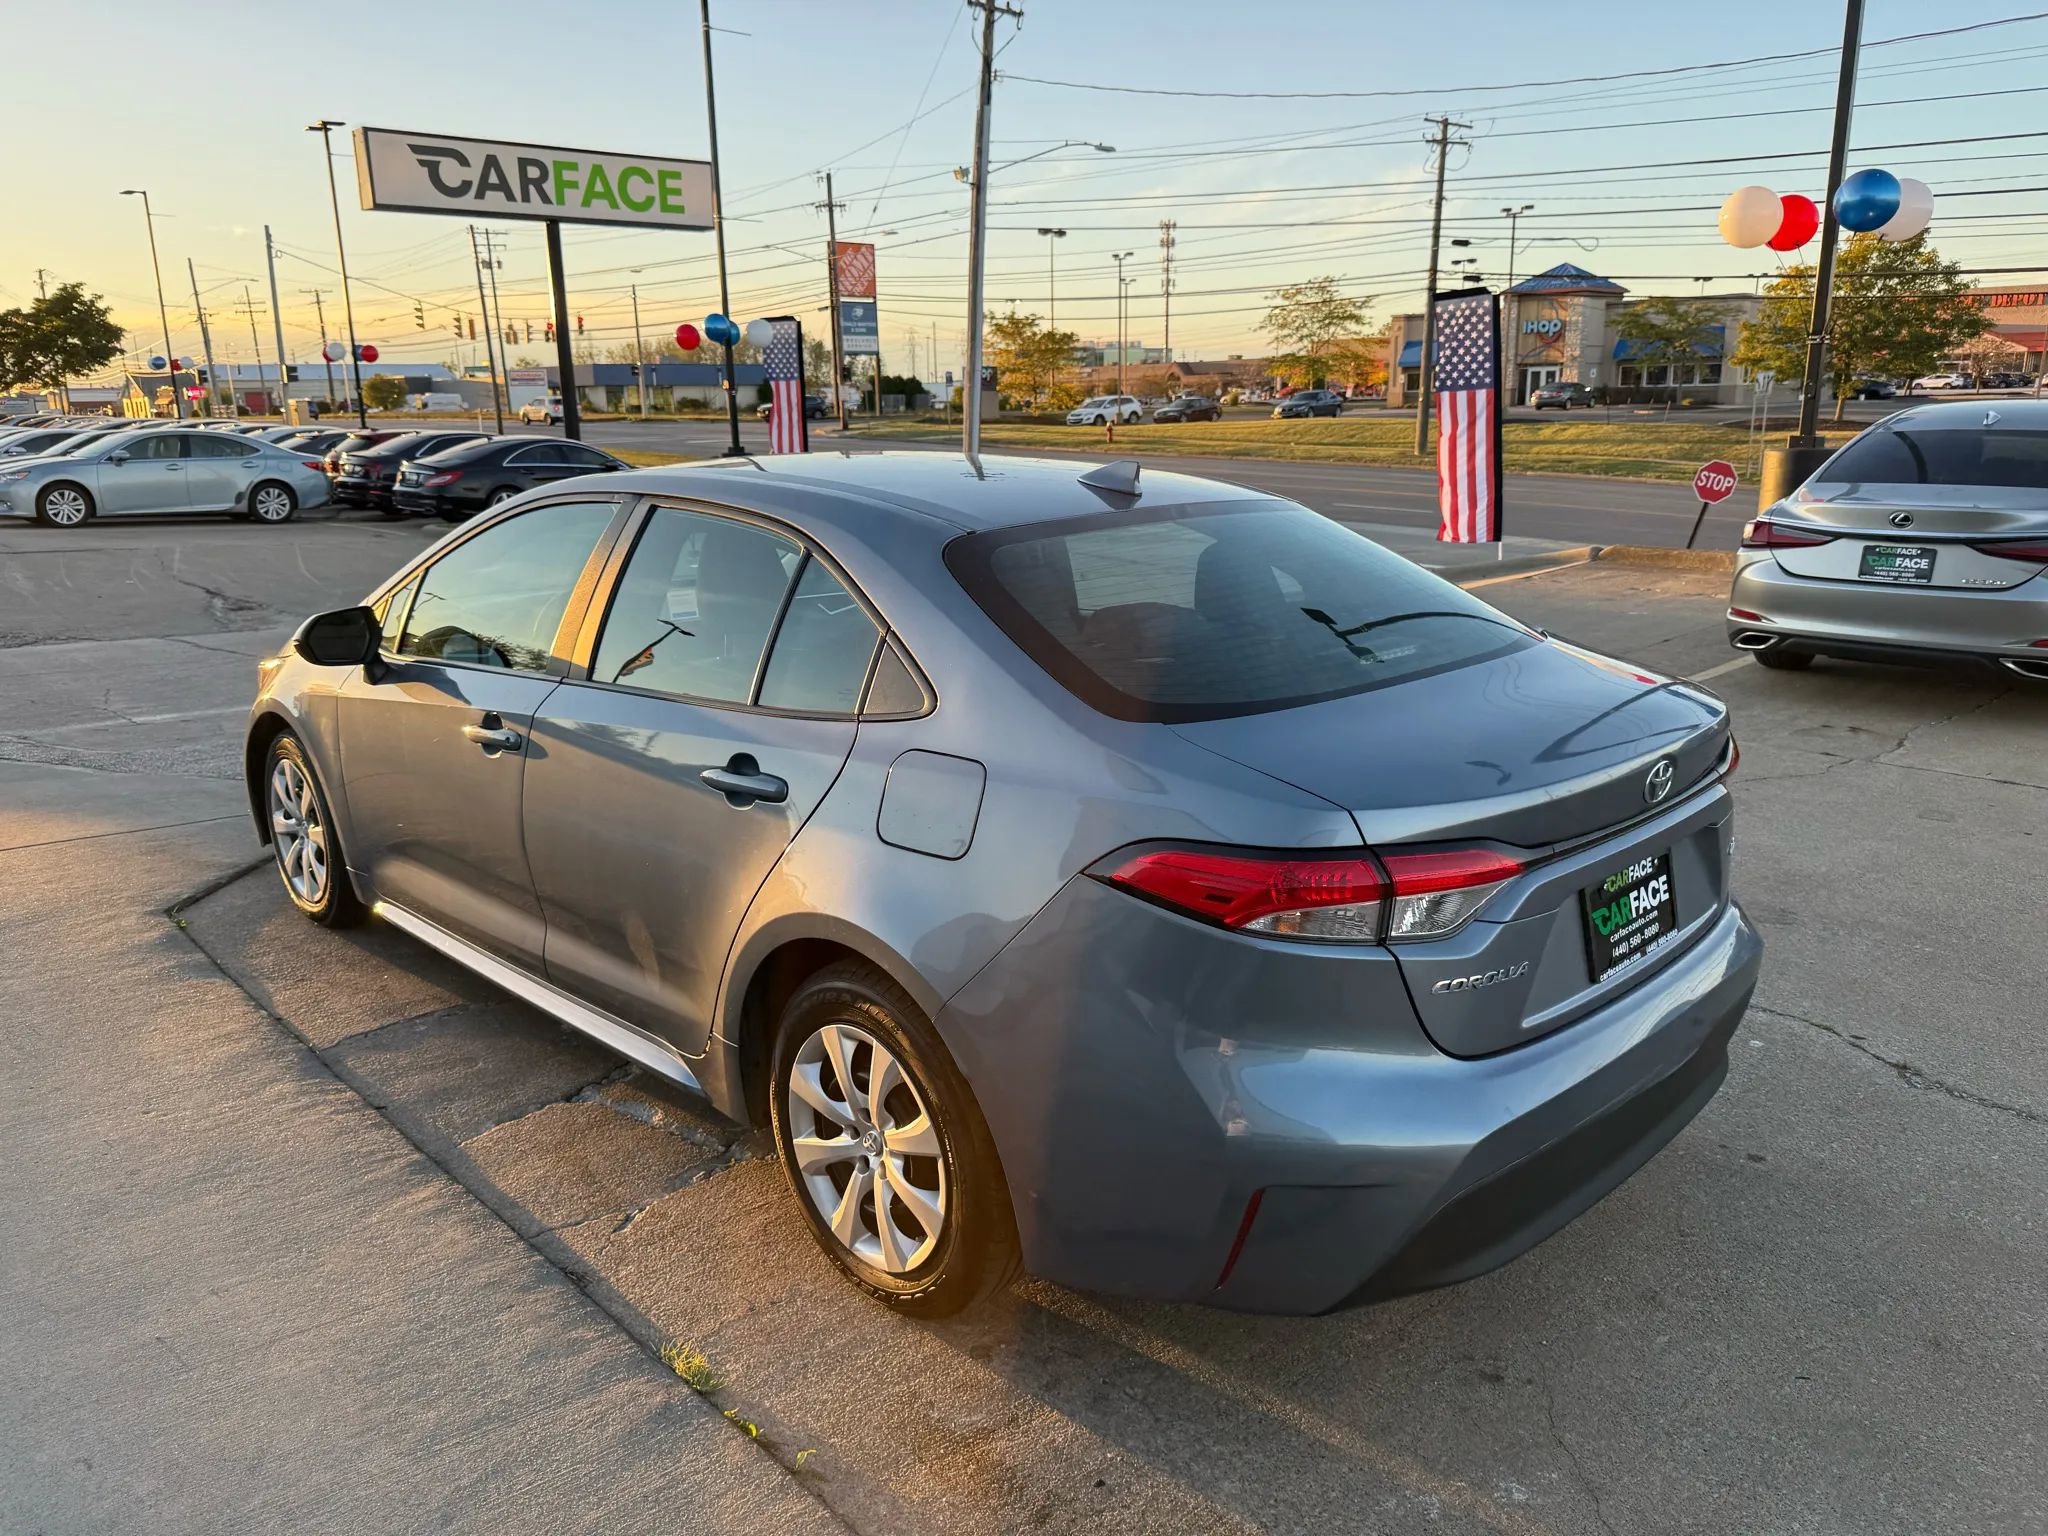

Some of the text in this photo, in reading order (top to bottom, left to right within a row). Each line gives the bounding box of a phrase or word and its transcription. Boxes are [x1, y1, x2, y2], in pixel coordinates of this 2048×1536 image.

[406, 143, 686, 214] CARFACE
[1697, 471, 1734, 492] STOP
[1866, 555, 1929, 569] CARFACE
[1880, 547, 1917, 556] CARFACE
[1606, 856, 1653, 892] CARFACE
[1592, 875, 1669, 935] CARFACE
[1610, 910, 1658, 942] carfaceauto.com
[1612, 922, 1660, 958] (440) 560-8080
[1431, 961, 1529, 994] COROLLA
